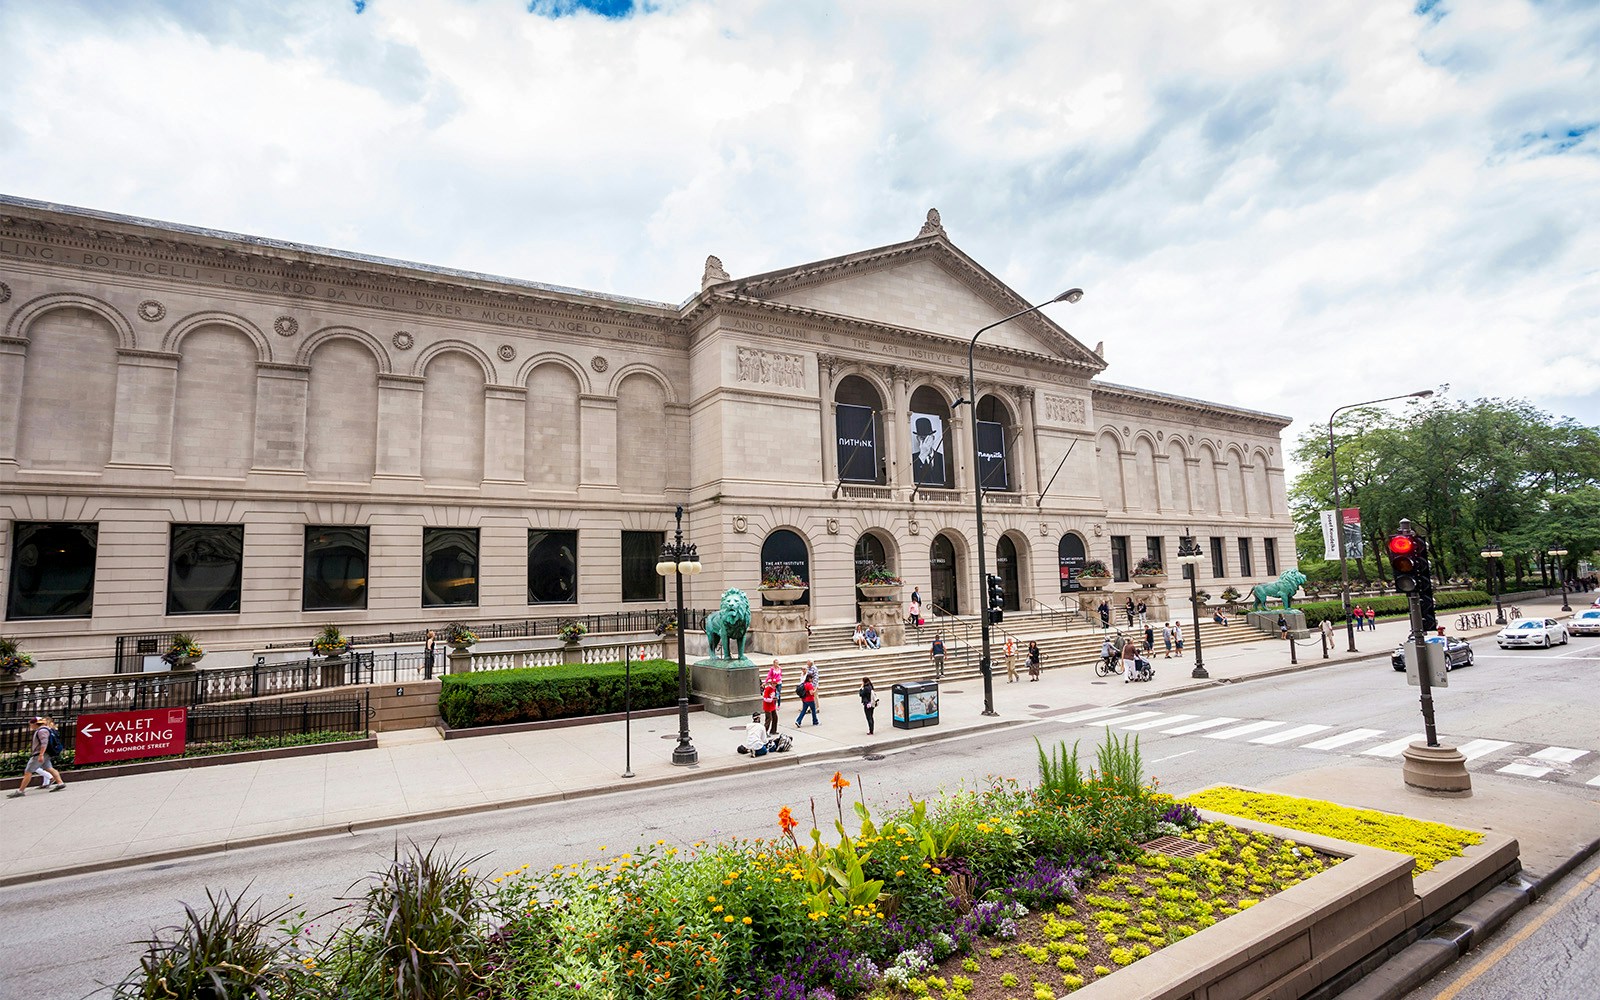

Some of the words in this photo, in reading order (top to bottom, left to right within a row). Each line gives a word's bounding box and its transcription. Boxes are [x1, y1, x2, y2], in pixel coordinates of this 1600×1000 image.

[83, 253, 199, 280] BOTTICELLI
[223, 273, 316, 296] LEONARDO
[327, 288, 347, 300] DA
[354, 291, 396, 306] VINCI
[415, 300, 463, 316] DVRER
[481, 310, 542, 327] MICHAEL
[547, 319, 602, 335] ANGELO
[617, 328, 670, 344] RAPHAEL
[734, 319, 764, 332] ANNO
[768, 324, 807, 339] DOMINI
[852, 338, 871, 350] THE
[881, 344, 899, 355] ART
[908, 349, 952, 364] INSTITVTE
[978, 360, 1011, 374] CHICAGO
[105, 718, 154, 732] VALET
[104, 729, 173, 746] PARKING
[116, 745, 146, 753] MONROE
[147, 742, 170, 750] STREET
